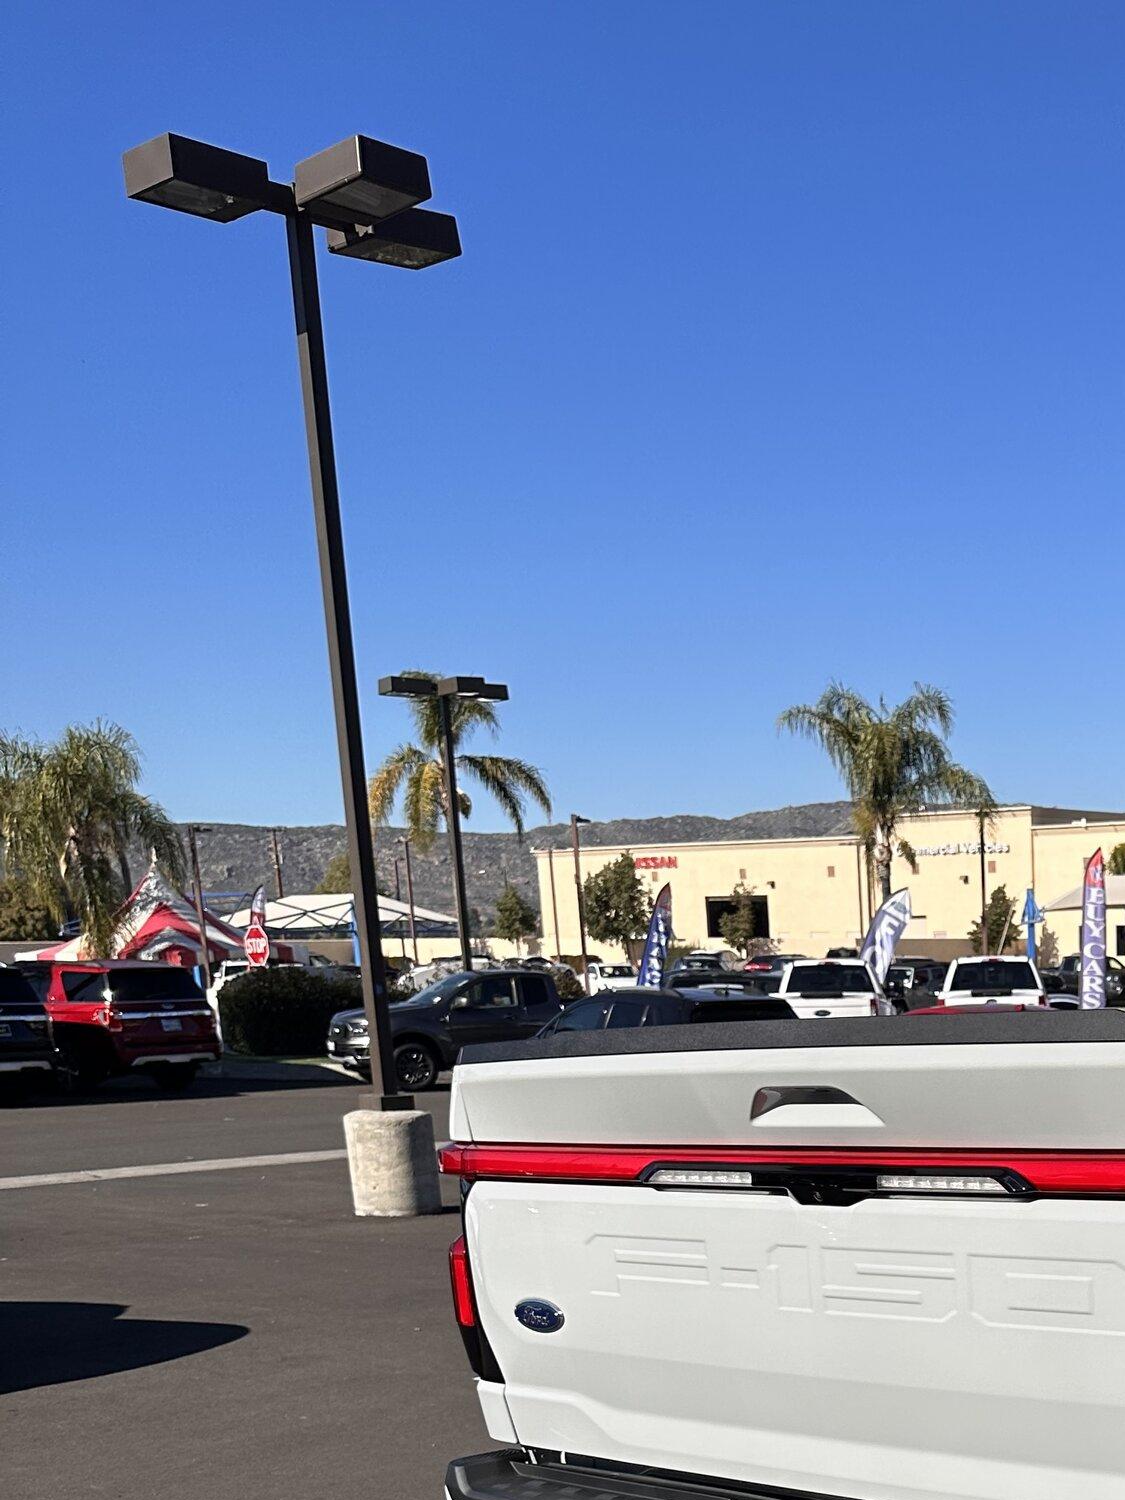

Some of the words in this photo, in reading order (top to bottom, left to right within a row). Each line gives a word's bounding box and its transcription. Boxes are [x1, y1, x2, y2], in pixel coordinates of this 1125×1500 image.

[635, 856, 678, 869] ISSAN
[246, 938, 267, 954] STOP
[1082, 942, 1105, 1009] CARS
